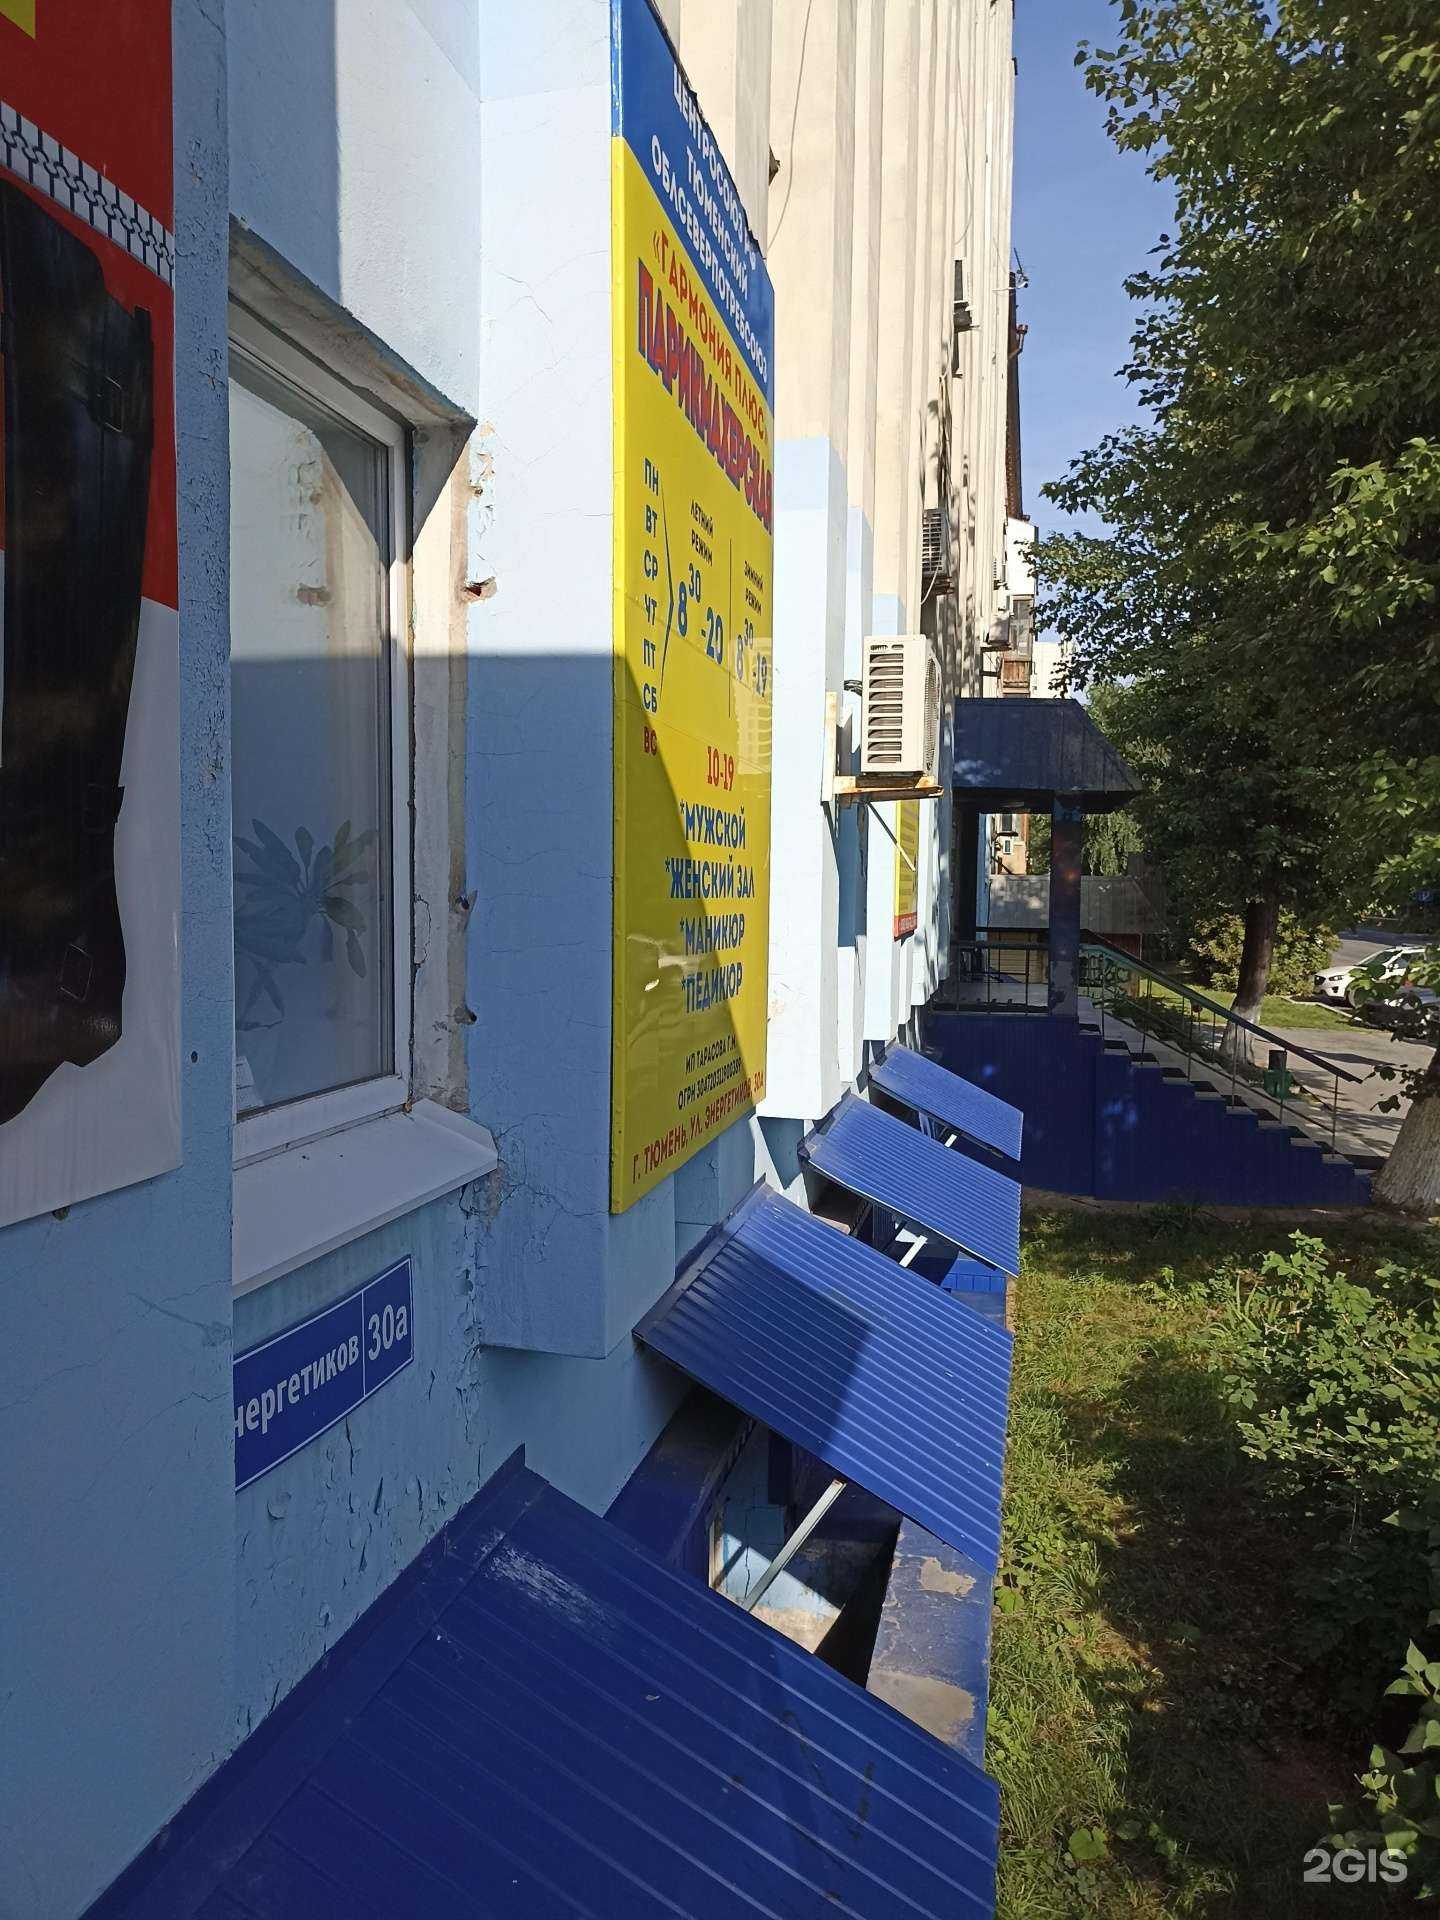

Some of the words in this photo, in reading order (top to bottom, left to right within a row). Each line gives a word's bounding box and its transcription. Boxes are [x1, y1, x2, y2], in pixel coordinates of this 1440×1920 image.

[687, 145, 747, 300] ТЮМЕНСКИЙ
[652, 134, 767, 384] ОБЛСЕВЕРПОТРЕБСОЮЗ
[639, 257, 772, 537] ПАРИКМАХЕРСКАЯ
[644, 457, 659, 496] ПН
[645, 504, 658, 538] ВТ
[690, 499, 714, 539] ЛЕТНИЙ
[643, 549, 659, 581] СР
[691, 529, 713, 567] РЕЖИМ
[644, 593, 658, 626] ЧТ
[643, 638, 657, 670] ПТ
[643, 682, 657, 713] СБ
[643, 726, 657, 756] ВС
[707, 745, 735, 792] 10-19
[737, 864, 755, 899] ЗАЛ
[686, 1052, 696, 1075] ИП
[697, 1039, 727, 1069] ТАРАСОВА
[678, 1085, 696, 1110] ОГРН
[690, 1113, 703, 1139] УЛ.
[368, 1304, 408, 1362] 30а
